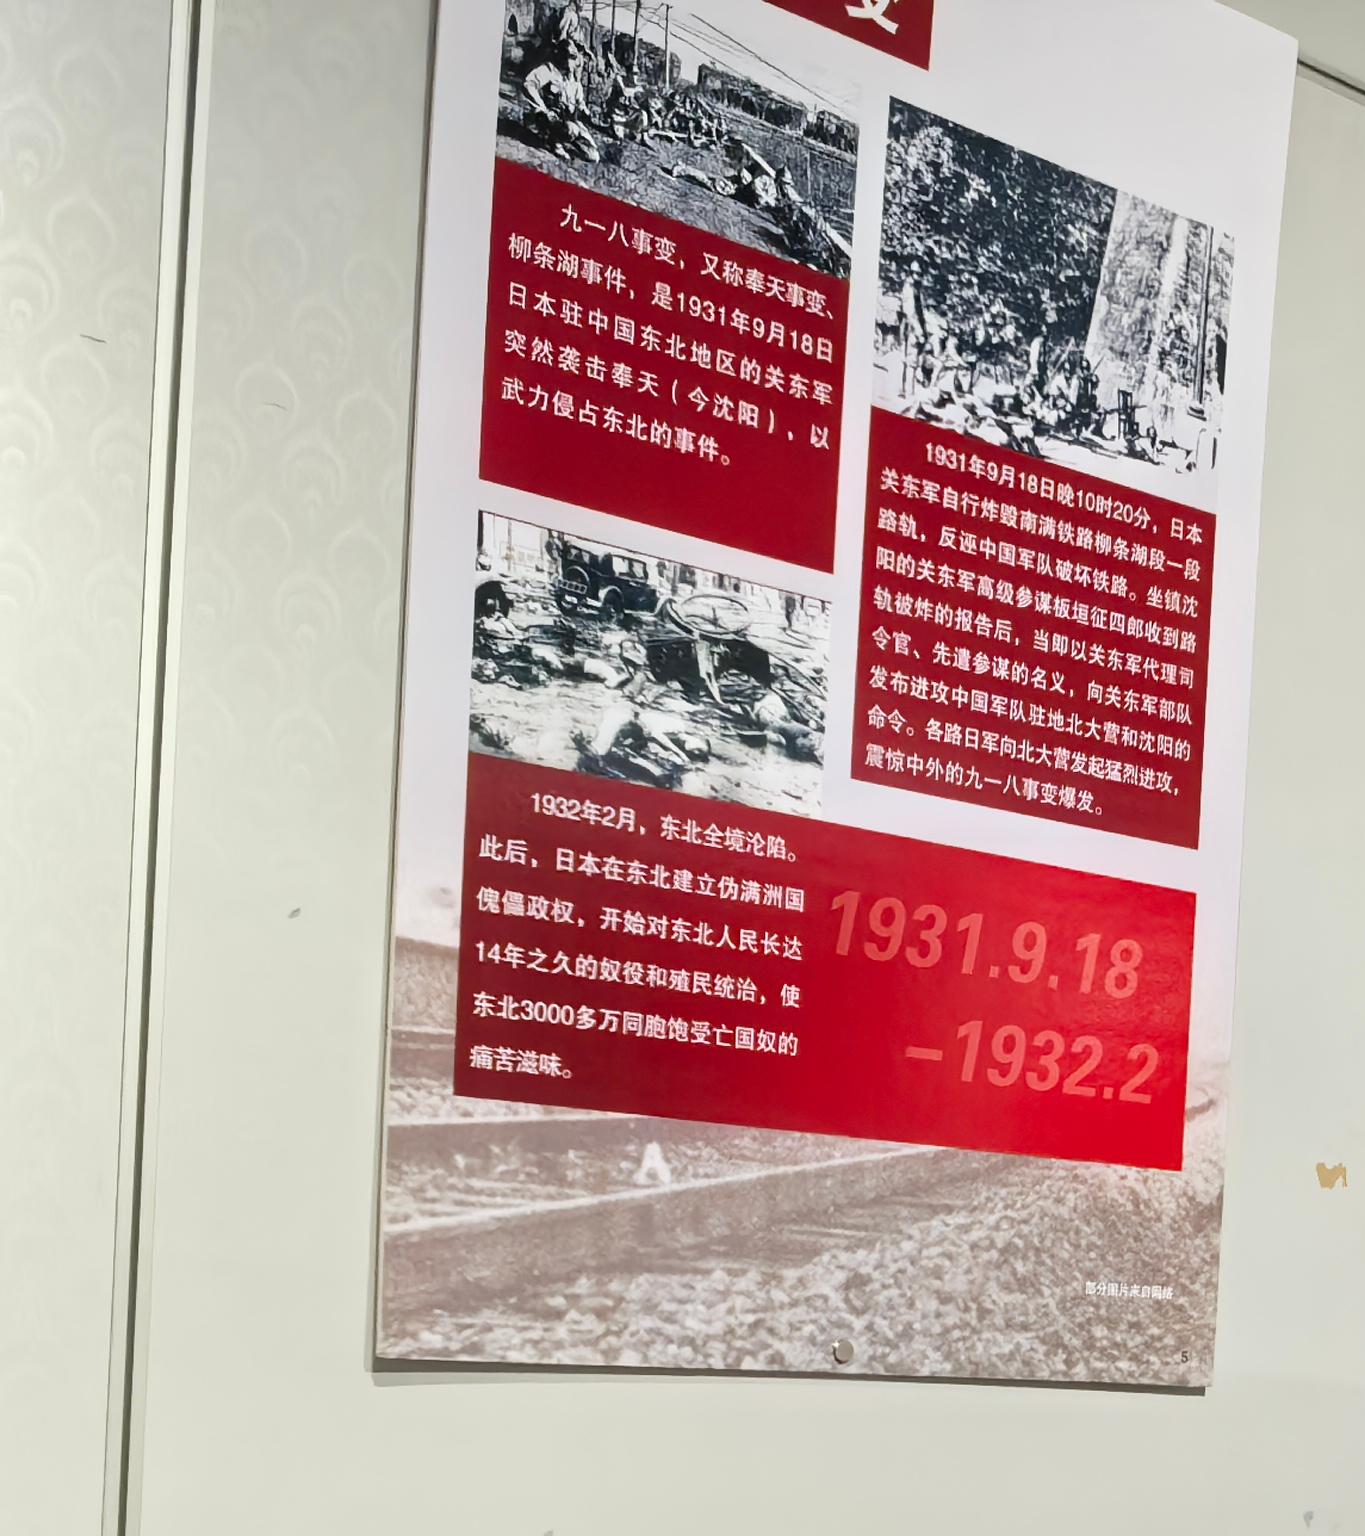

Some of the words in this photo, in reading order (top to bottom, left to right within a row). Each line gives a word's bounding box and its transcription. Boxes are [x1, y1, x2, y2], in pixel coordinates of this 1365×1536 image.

[508, 280, 833, 406] 日本驻中国东北地区的关东军
[501, 376, 731, 467] 武力侵占东北的事件。
[829, 889, 1143, 1001] 1931.9.18
[469, 1044, 575, 1081] 痛苦滋味。
[471, 989, 798, 1057] 东北3000多万同胞饱受亡国奴的
[1181, 1350, 1189, 1364] 5
